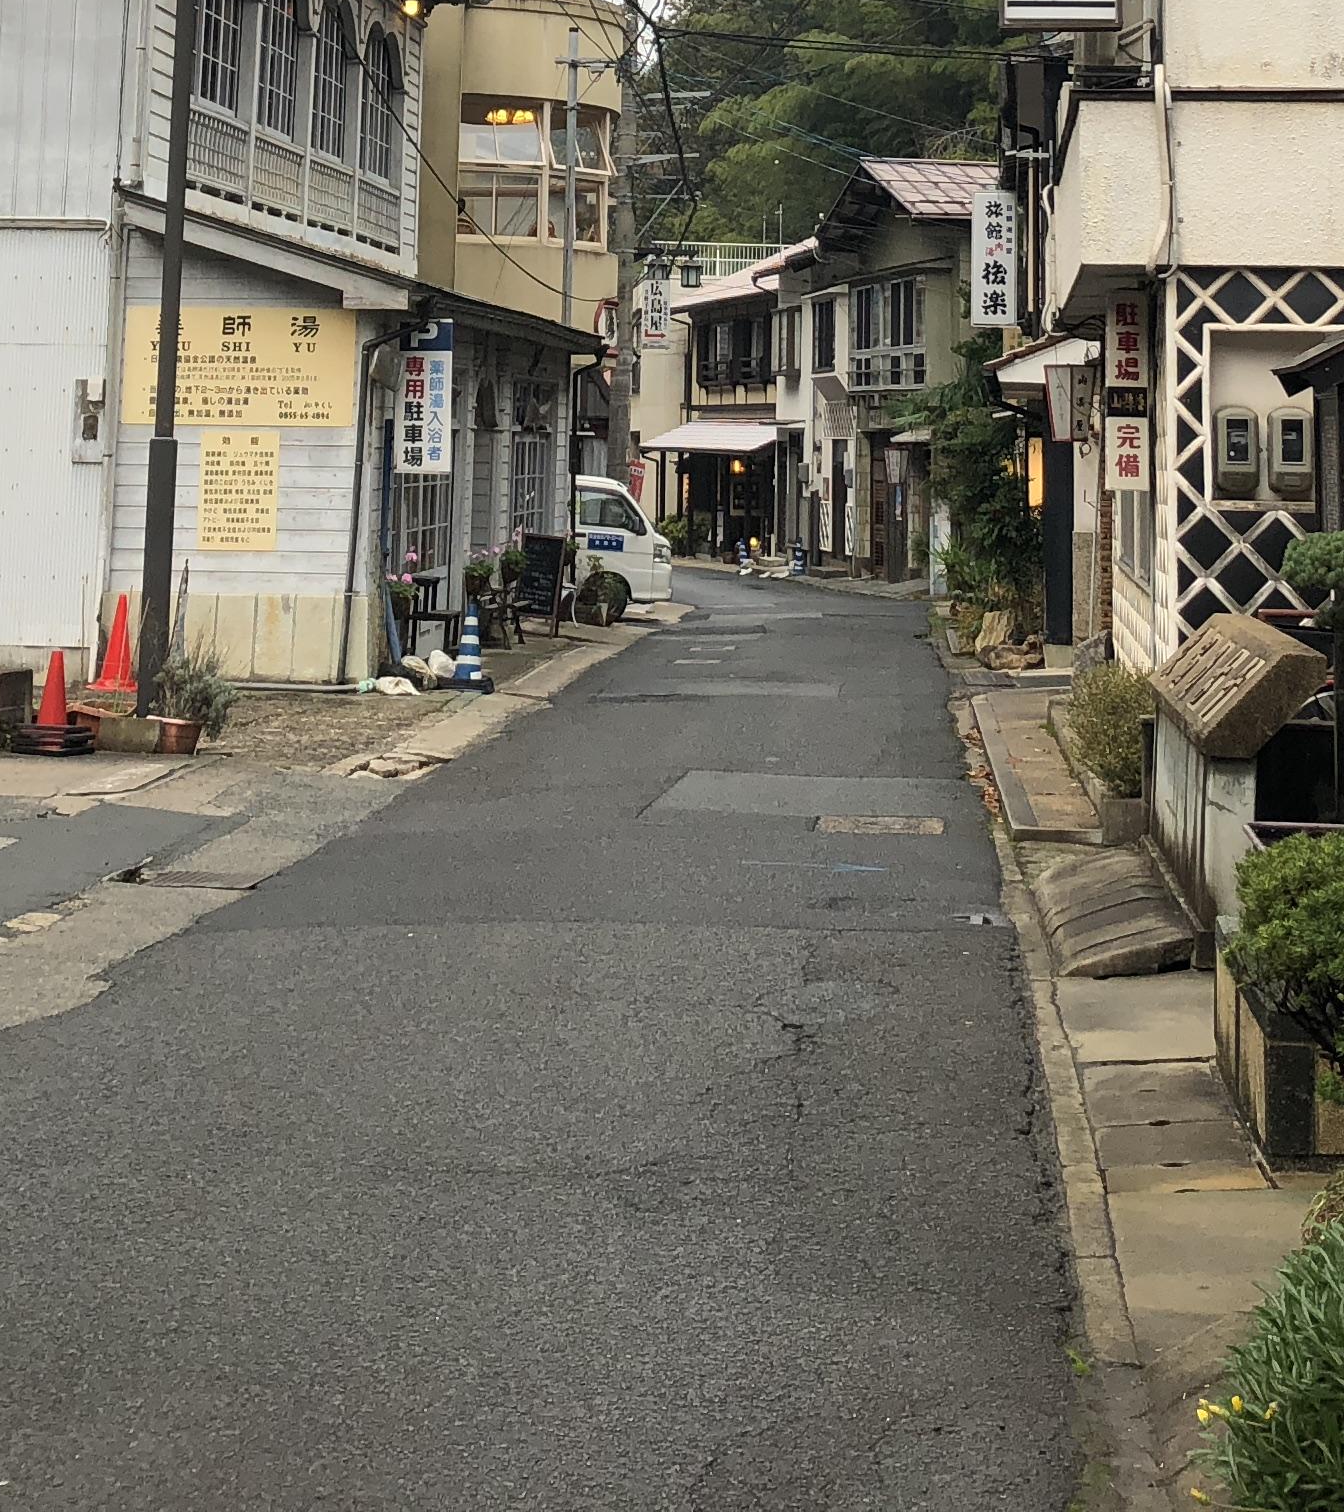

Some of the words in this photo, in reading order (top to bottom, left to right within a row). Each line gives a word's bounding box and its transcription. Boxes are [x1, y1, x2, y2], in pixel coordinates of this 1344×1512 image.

[985, 201, 1004, 240] 旅館
[221, 340, 251, 353] SHI
[293, 341, 317, 353] YU
[410, 322, 439, 348] P
[1115, 303, 1140, 382] 駐車場
[278, 400, 293, 409] Tel
[402, 355, 425, 468] 専用駐車場
[426, 359, 445, 462] 薬師湯入浴者
[1115, 423, 1141, 478] 完備
